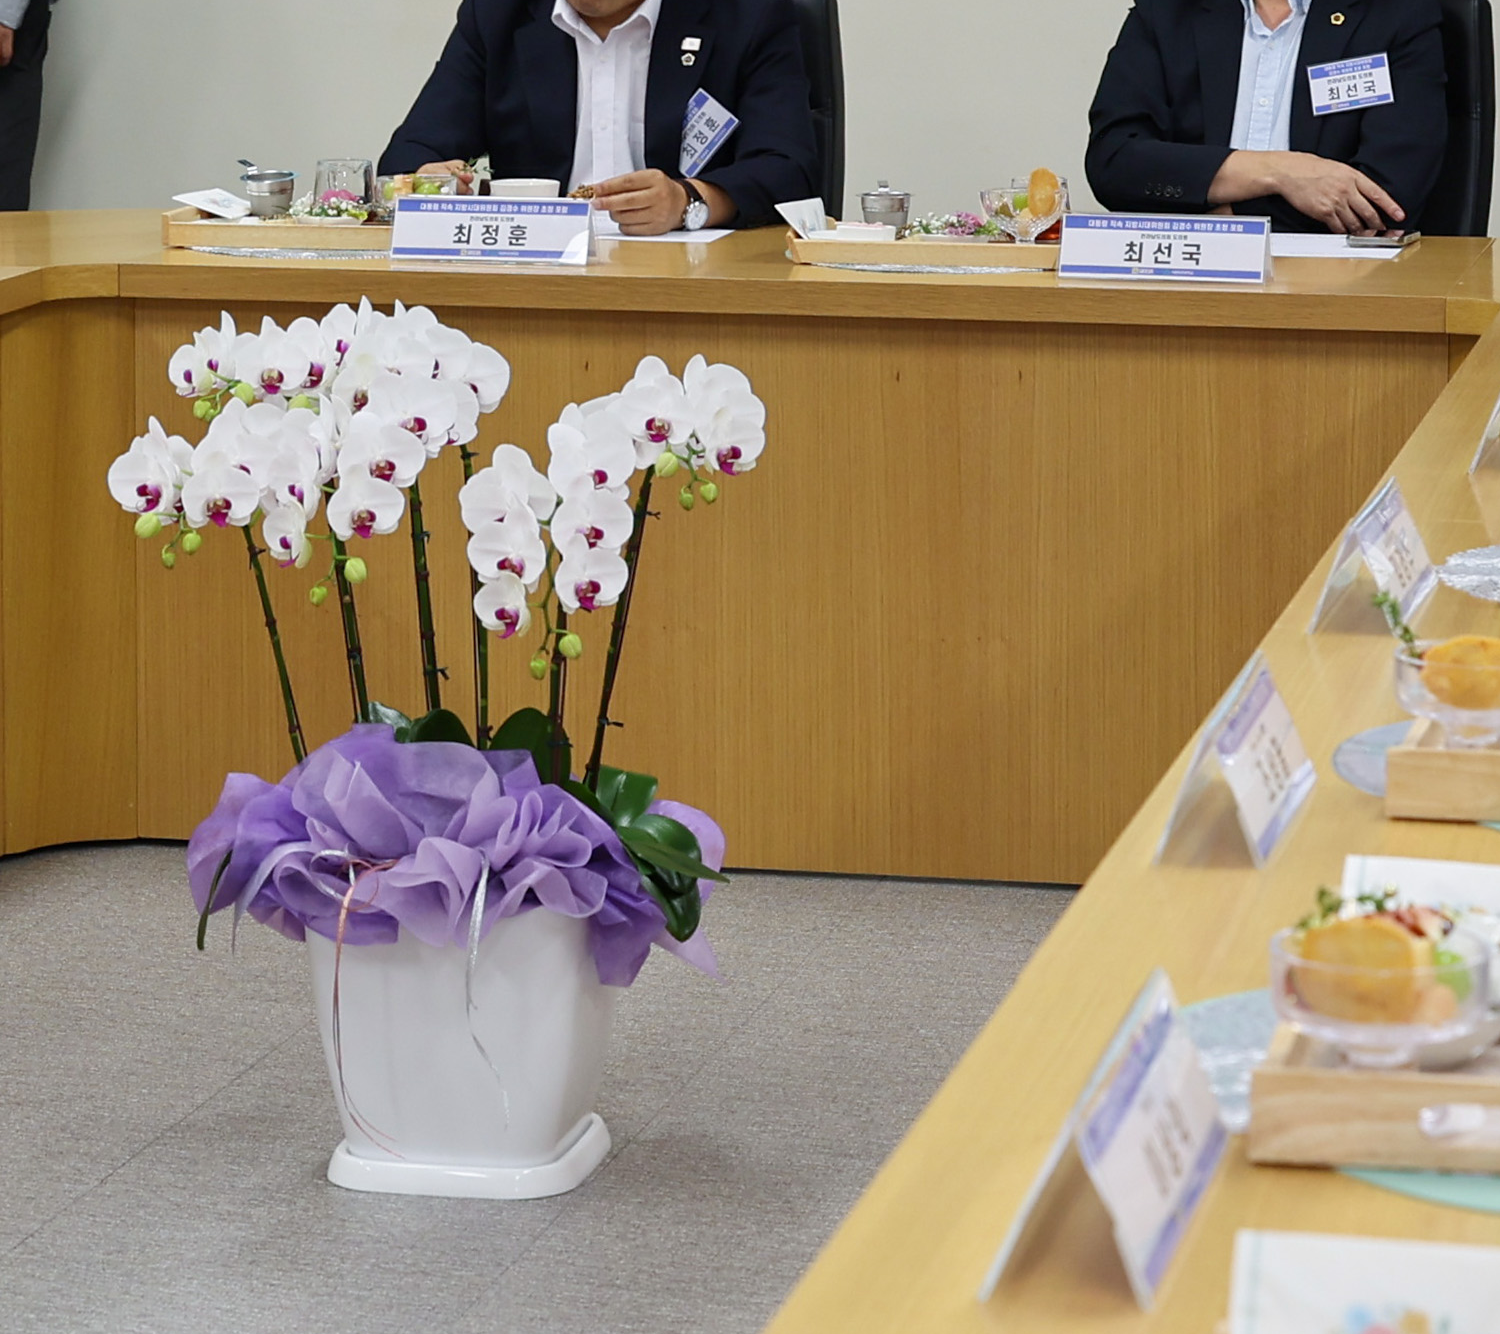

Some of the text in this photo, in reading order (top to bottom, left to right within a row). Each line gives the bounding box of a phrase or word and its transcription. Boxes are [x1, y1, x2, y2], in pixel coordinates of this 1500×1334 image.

[1328, 80, 1377, 101] 최선국
[682, 116, 720, 159] 최정훈
[420, 202, 439, 210] 대통령
[455, 203, 498, 211] 지방시대위원회
[500, 204, 518, 212] 김경수
[452, 223, 527, 246] 최정훈
[1088, 219, 1107, 227] 대통령
[1110, 220, 1123, 228] 직속
[1125, 220, 1170, 229] 지방시대위원회
[1172, 222, 1191, 230] 김경수
[1194, 223, 1213, 231] 위원장
[1123, 241, 1202, 265] 최선국
